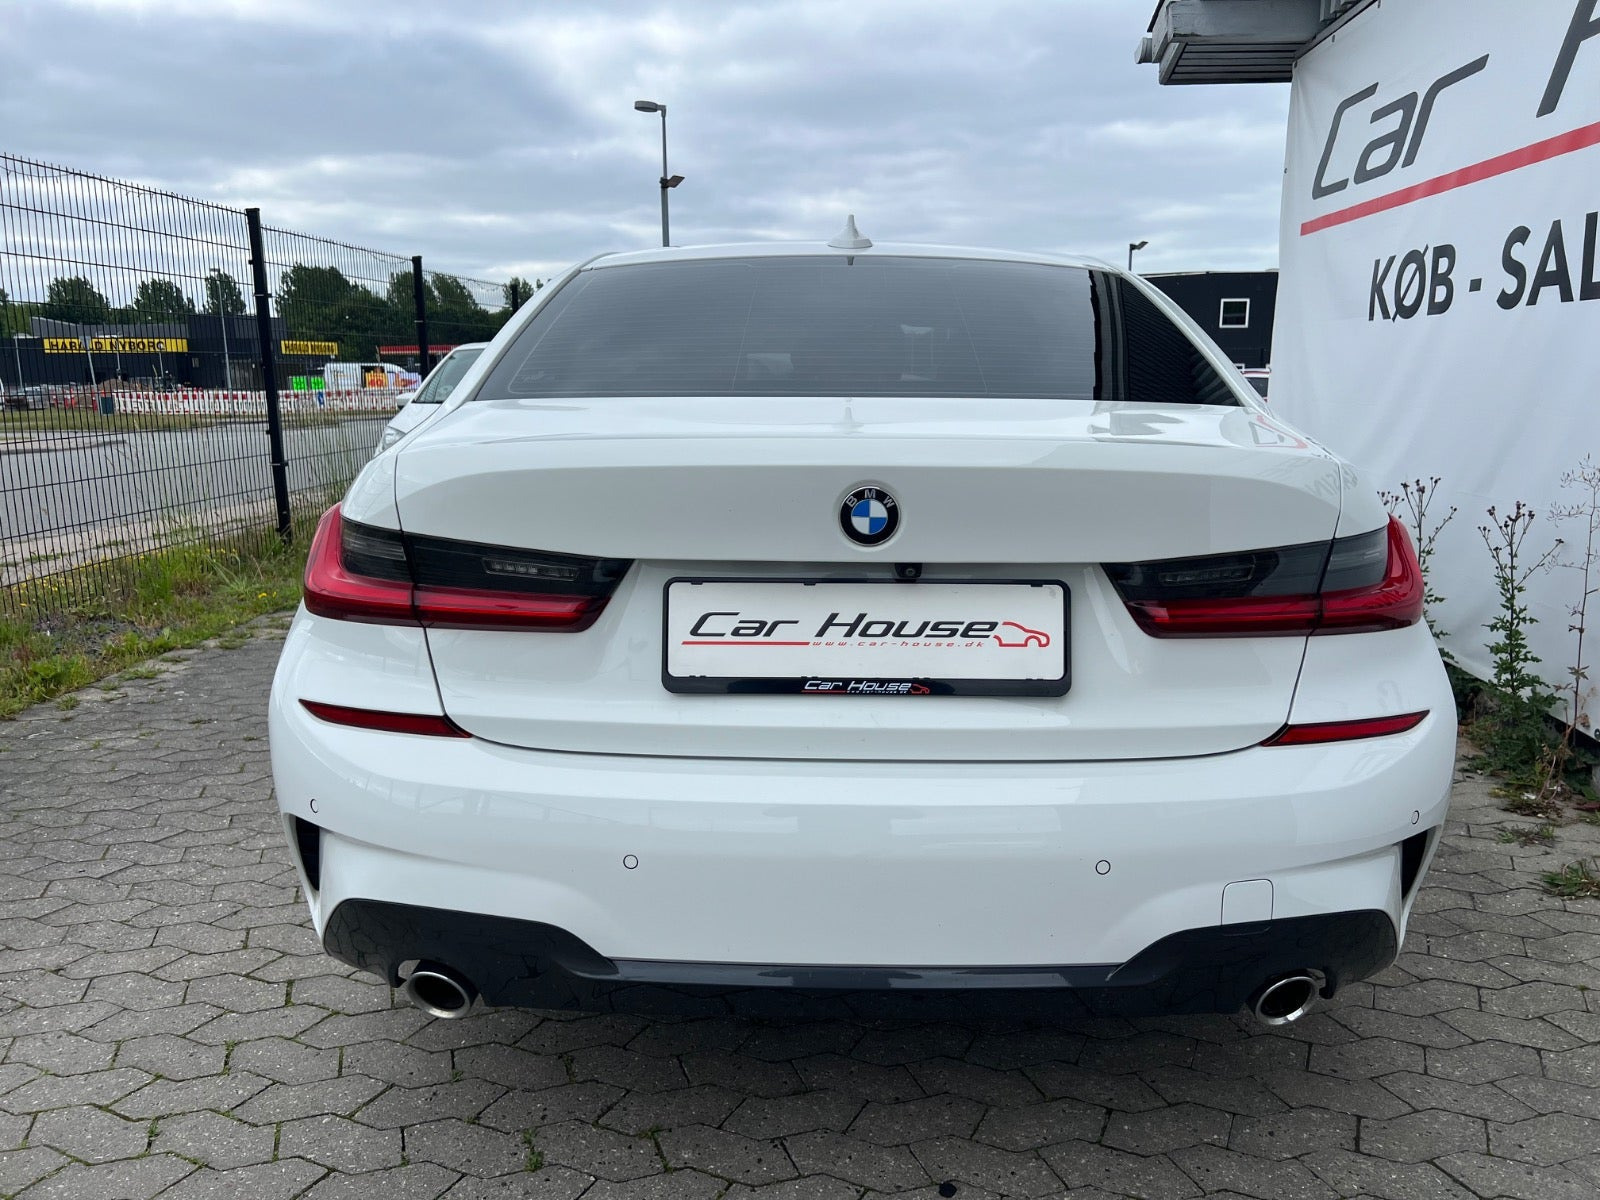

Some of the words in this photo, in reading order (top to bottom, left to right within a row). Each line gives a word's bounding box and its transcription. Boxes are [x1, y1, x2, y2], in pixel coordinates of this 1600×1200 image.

[1312, 53, 1490, 200] Car
[1368, 244, 1456, 323] KØB
[846, 489, 895, 508] BMW
[689, 611, 799, 637] Car
[814, 612, 999, 639] House
[812, 640, 985, 648] www.car-house.dk
[804, 680, 842, 690] Car
[847, 680, 912, 691] House
